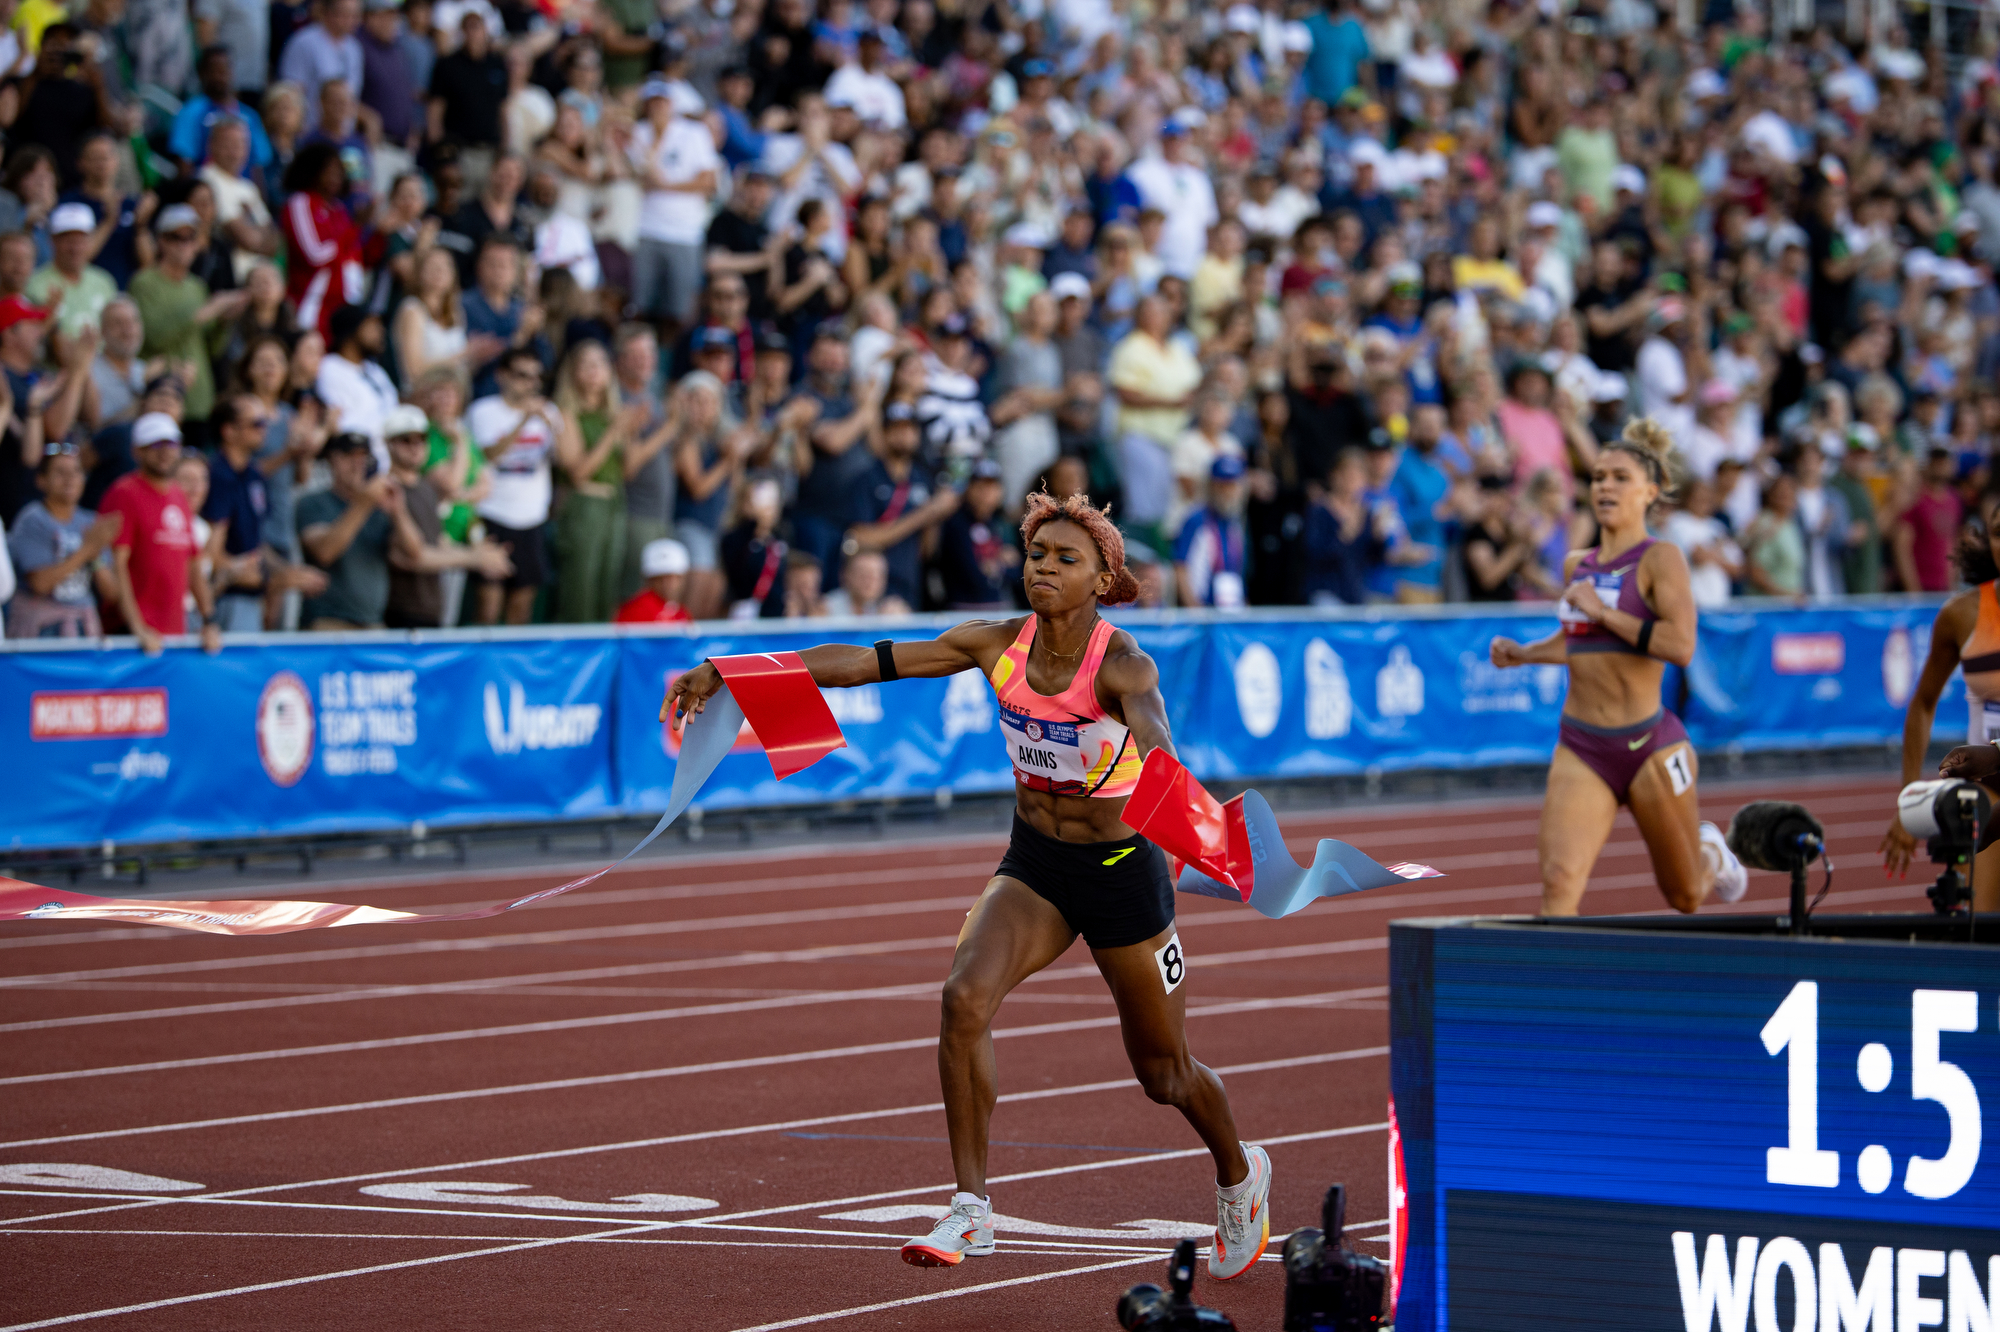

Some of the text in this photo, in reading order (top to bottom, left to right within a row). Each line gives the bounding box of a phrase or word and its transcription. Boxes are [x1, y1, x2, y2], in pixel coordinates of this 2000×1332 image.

[1019, 745, 1057, 769] AKINS
[1672, 756, 1686, 785] 1
[196, 913, 255, 926] TRIALS
[1163, 943, 1182, 985] 8
[1759, 980, 2000, 1200] 1:5
[1671, 1231, 2000, 1332] WOMEN
